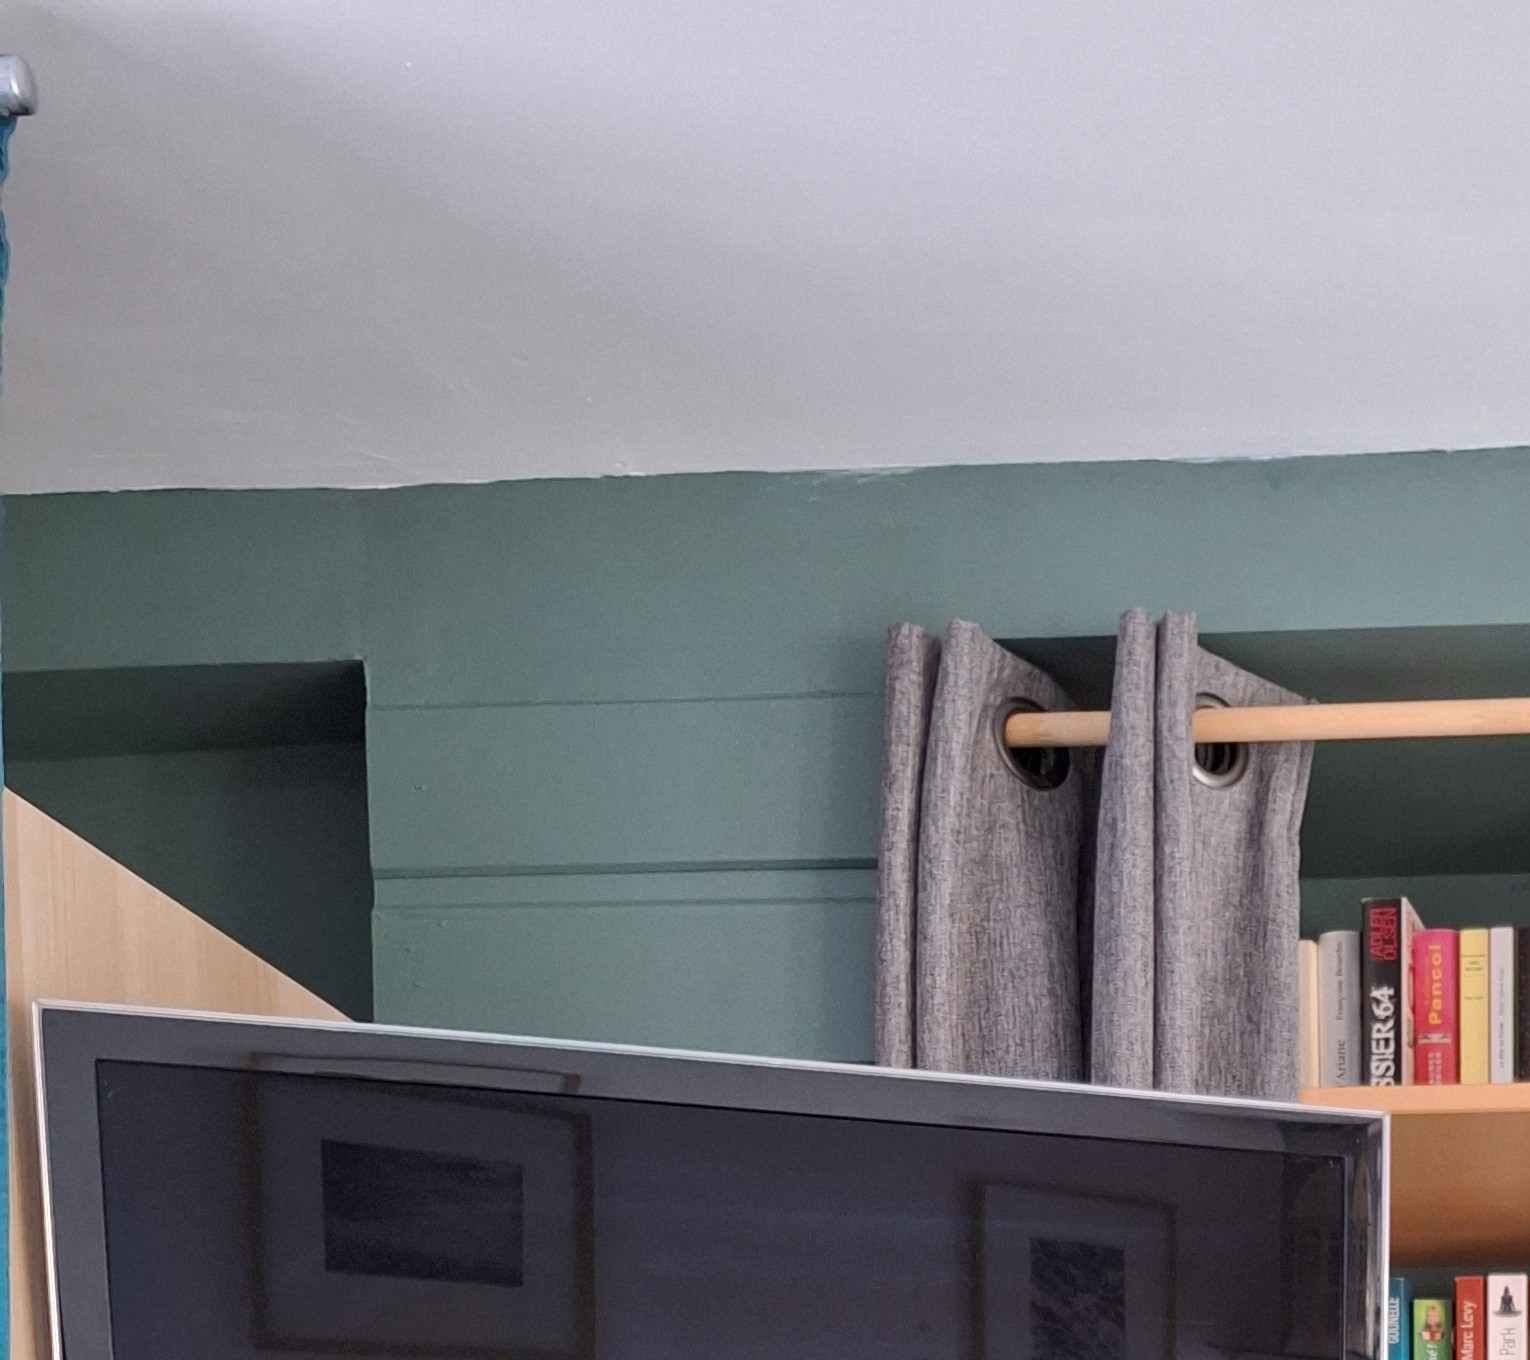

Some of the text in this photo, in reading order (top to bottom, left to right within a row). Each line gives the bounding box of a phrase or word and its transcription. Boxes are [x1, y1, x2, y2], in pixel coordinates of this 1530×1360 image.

[1428, 944, 1443, 1025] Pancol
[1460, 1301, 1477, 1329] Levy
[1494, 1328, 1516, 1356] Park
